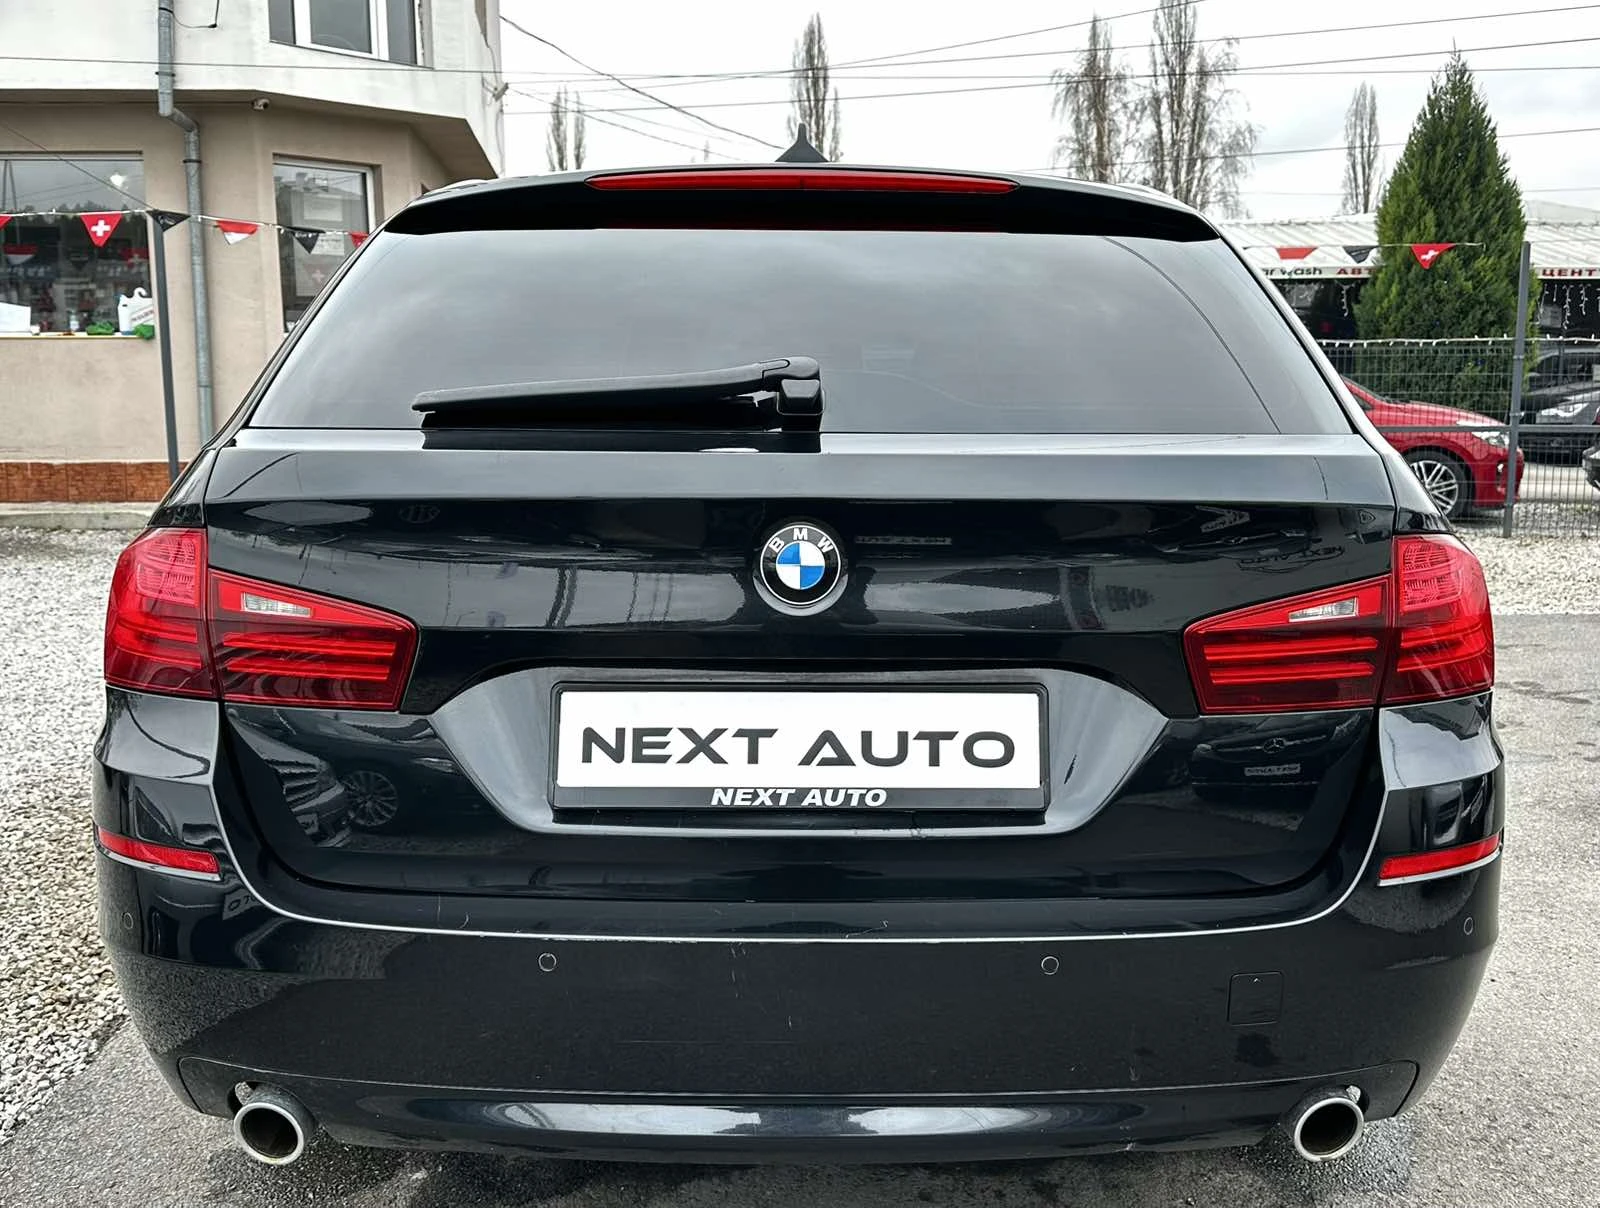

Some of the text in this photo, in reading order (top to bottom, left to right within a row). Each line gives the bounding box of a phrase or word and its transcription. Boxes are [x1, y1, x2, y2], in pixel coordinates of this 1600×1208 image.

[1542, 268, 1600, 276] ЦЕНТ
[769, 528, 834, 553] BMW
[582, 726, 1015, 768] NEXT AUTO
[711, 788, 888, 807] NEXT AUTO
